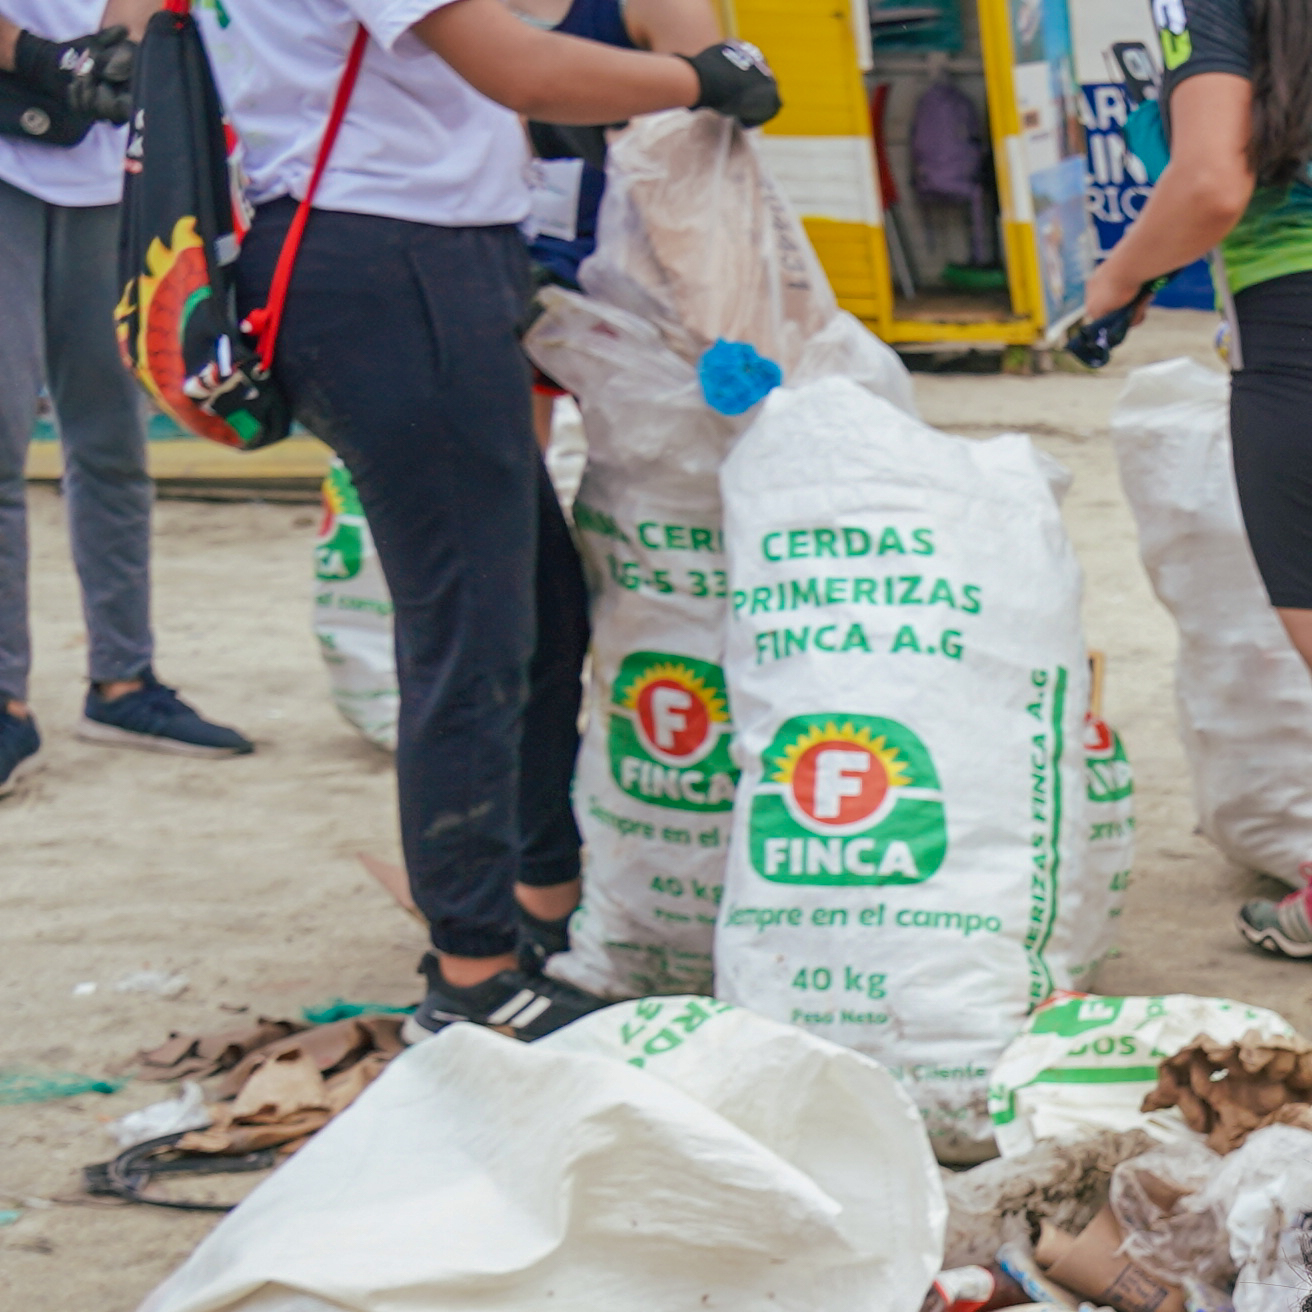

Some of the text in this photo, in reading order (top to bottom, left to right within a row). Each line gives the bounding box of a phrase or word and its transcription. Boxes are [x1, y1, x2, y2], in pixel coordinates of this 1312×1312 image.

[761, 526, 935, 562] CERDAS
[733, 575, 982, 622] PRIMERIZAS
[755, 623, 964, 664] FINCA A.G
[619, 755, 735, 805] FINCA
[763, 837, 919, 878] FINCA
[810, 907, 847, 928] en
[857, 903, 887, 929] el
[895, 907, 1003, 937] campo
[791, 966, 888, 1000] 40 kg
